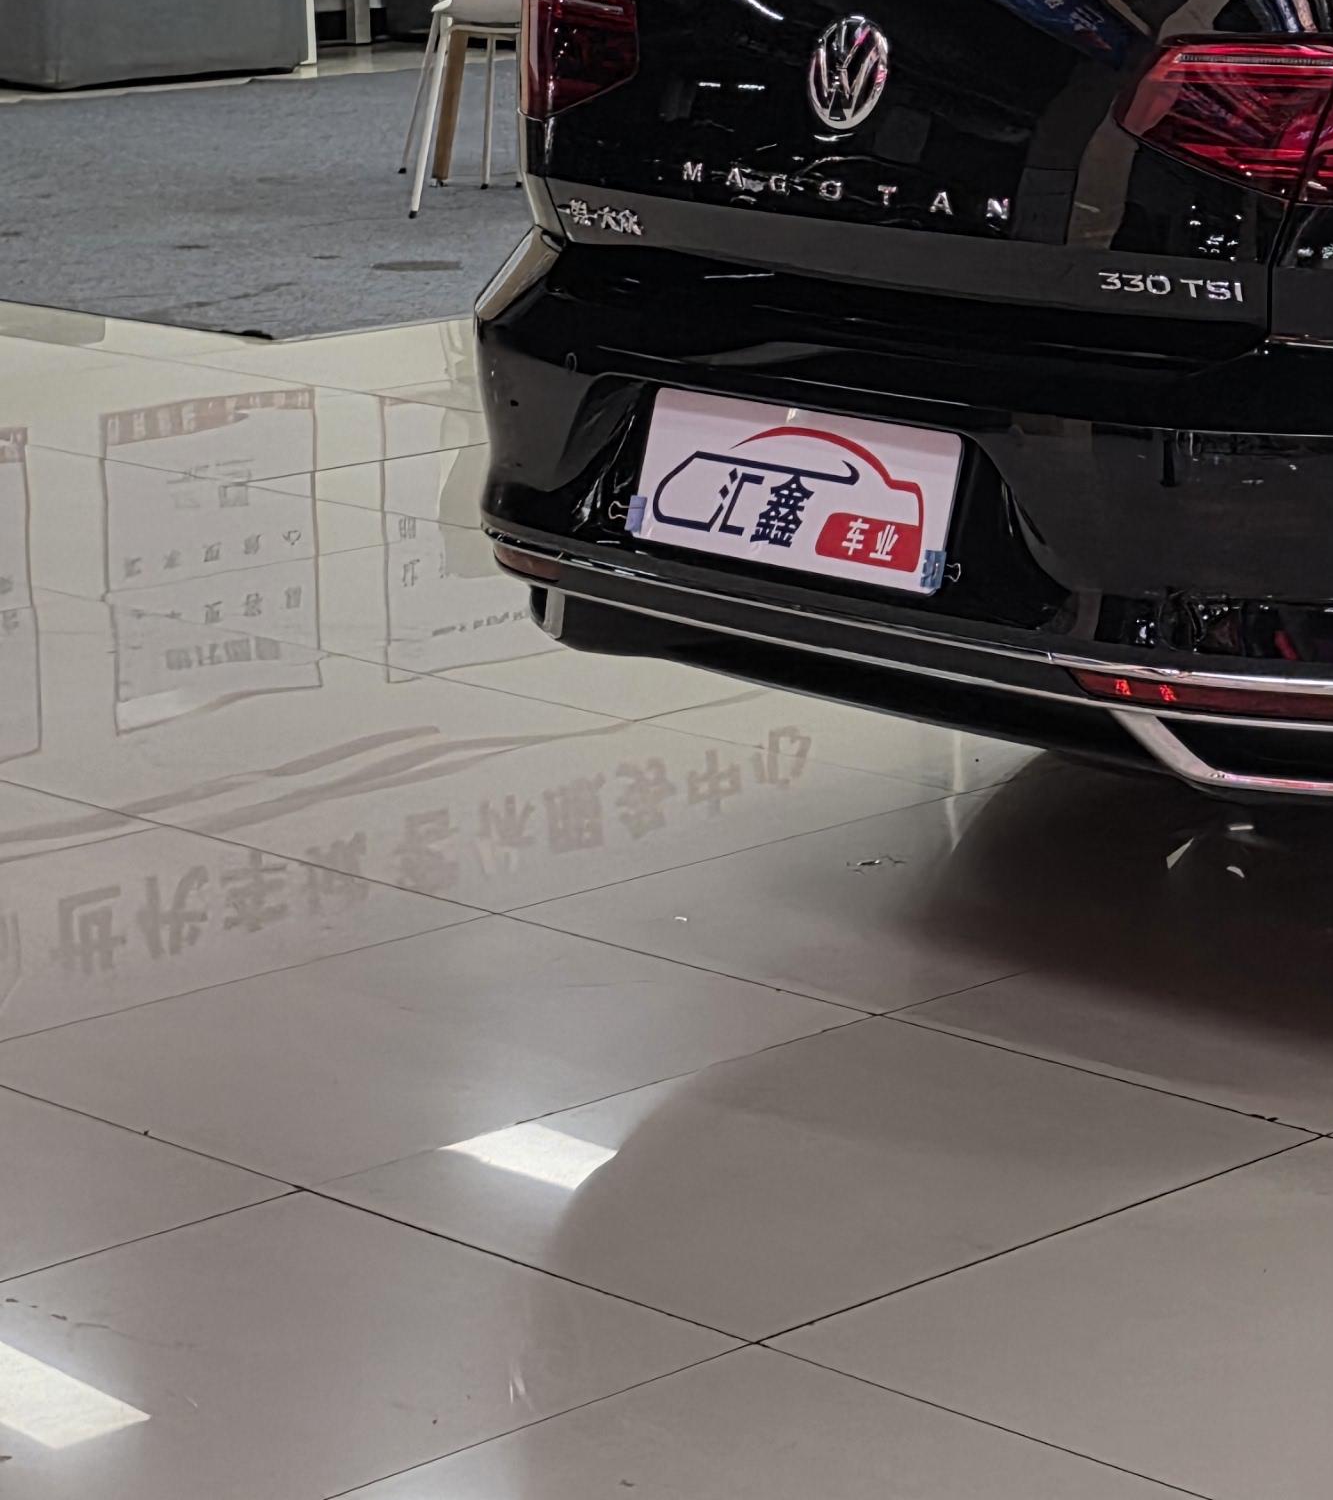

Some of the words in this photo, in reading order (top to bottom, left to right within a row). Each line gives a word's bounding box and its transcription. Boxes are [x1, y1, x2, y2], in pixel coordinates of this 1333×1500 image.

[682, 161, 1009, 220] MAGOTAN
[1098, 272, 1172, 295] 330
[1179, 278, 1244, 302] TSI
[709, 467, 815, 548] 汇鑫
[841, 518, 899, 561] 车业
